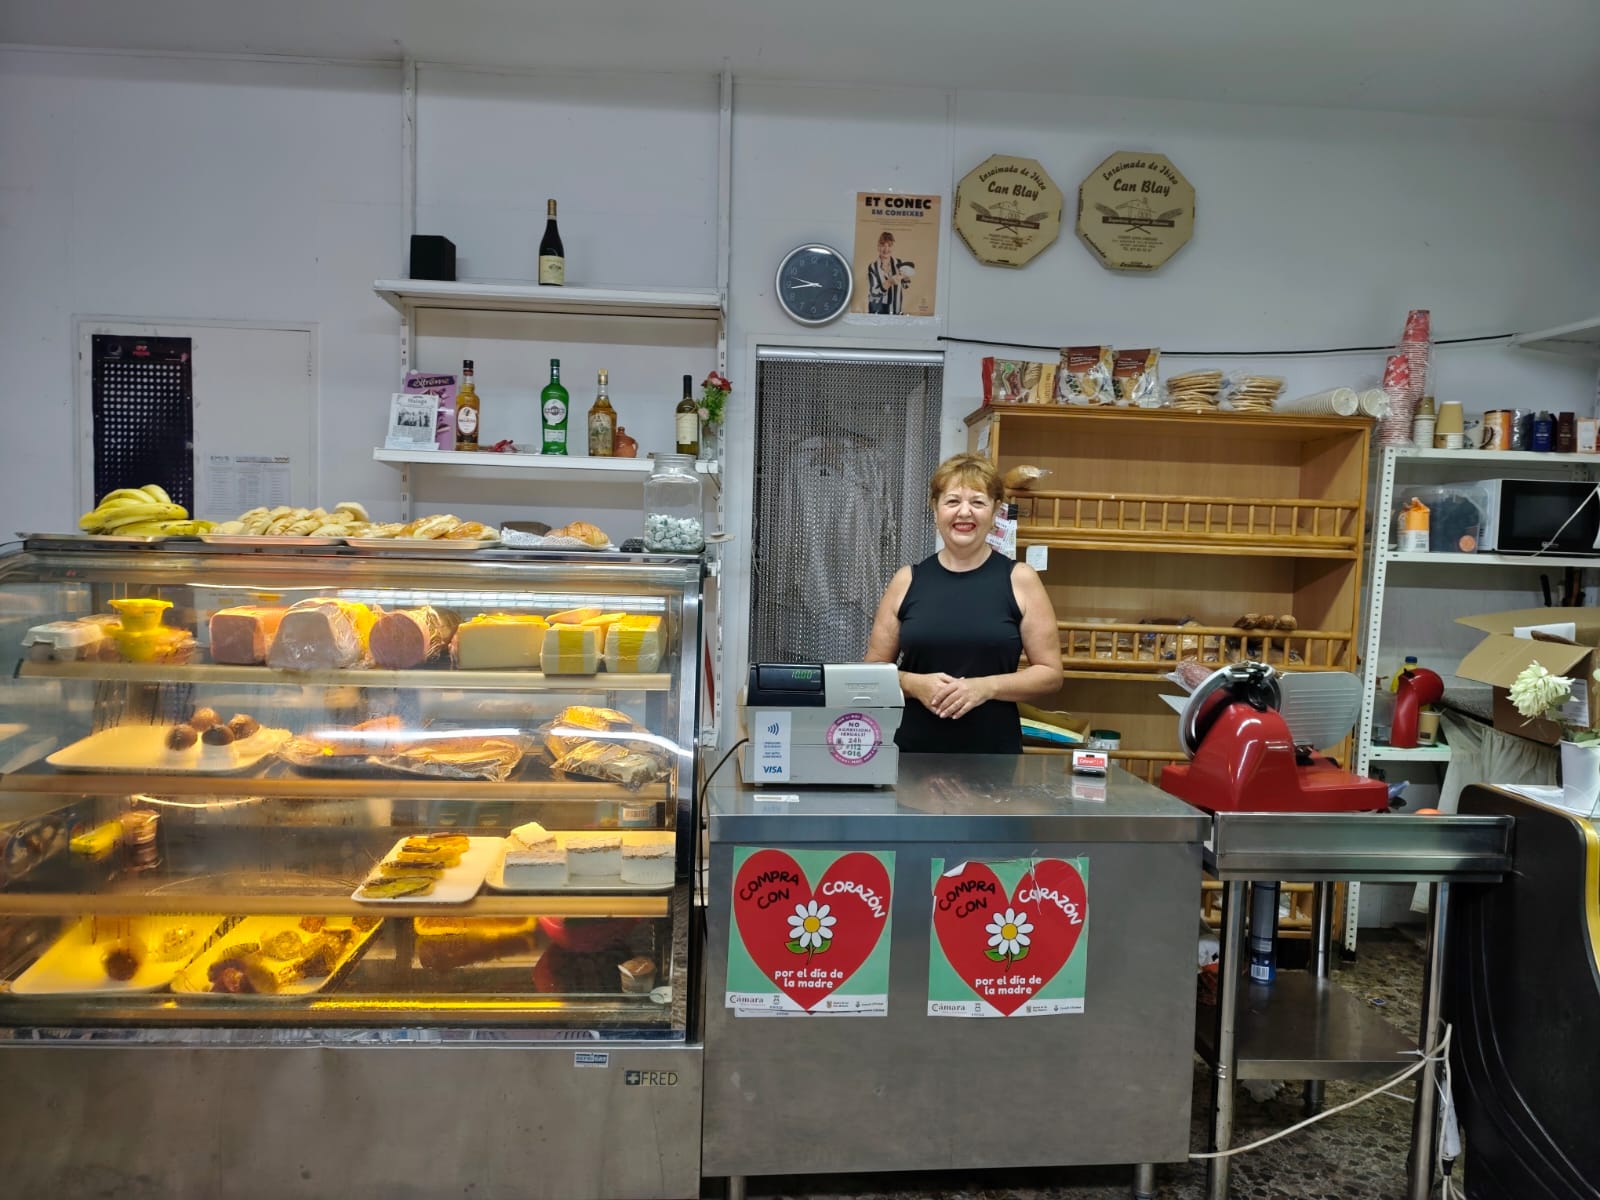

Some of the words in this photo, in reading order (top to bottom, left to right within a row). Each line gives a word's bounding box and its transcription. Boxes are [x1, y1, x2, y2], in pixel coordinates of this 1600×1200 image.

[979, 164, 1018, 183] Ensaimada
[1020, 167, 1030, 176] de
[1102, 160, 1146, 182] Ensaimada
[1147, 161, 1160, 171] de
[987, 180, 1009, 195] Can
[1011, 184, 1039, 201] Blay
[1112, 178, 1137, 193] Can
[1140, 181, 1171, 197] Blay
[865, 197, 881, 206] ET
[884, 198, 932, 209] CONEC
[763, 766, 782, 774] VISA
[739, 870, 800, 901] COMPRA
[757, 888, 790, 910] CON
[822, 881, 886, 919] CORAZÓN
[938, 880, 996, 912] COMPRA
[955, 897, 987, 919] CON
[1018, 888, 1082, 926] CORAZÓN
[774, 970, 794, 980] por
[797, 969, 807, 978] el
[810, 969, 827, 978] día
[830, 969, 844, 978] de
[784, 979, 795, 988] la
[798, 979, 834, 988] madre
[975, 977, 994, 987] por
[997, 976, 1006, 984] el
[1009, 975, 1026, 984] día
[1029, 975, 1042, 984] de
[729, 995, 764, 1004] Cámara
[984, 986, 995, 995] la
[998, 985, 1032, 995] madre
[931, 1003, 966, 1012] Cámara
[641, 1072, 678, 1086] FRED
